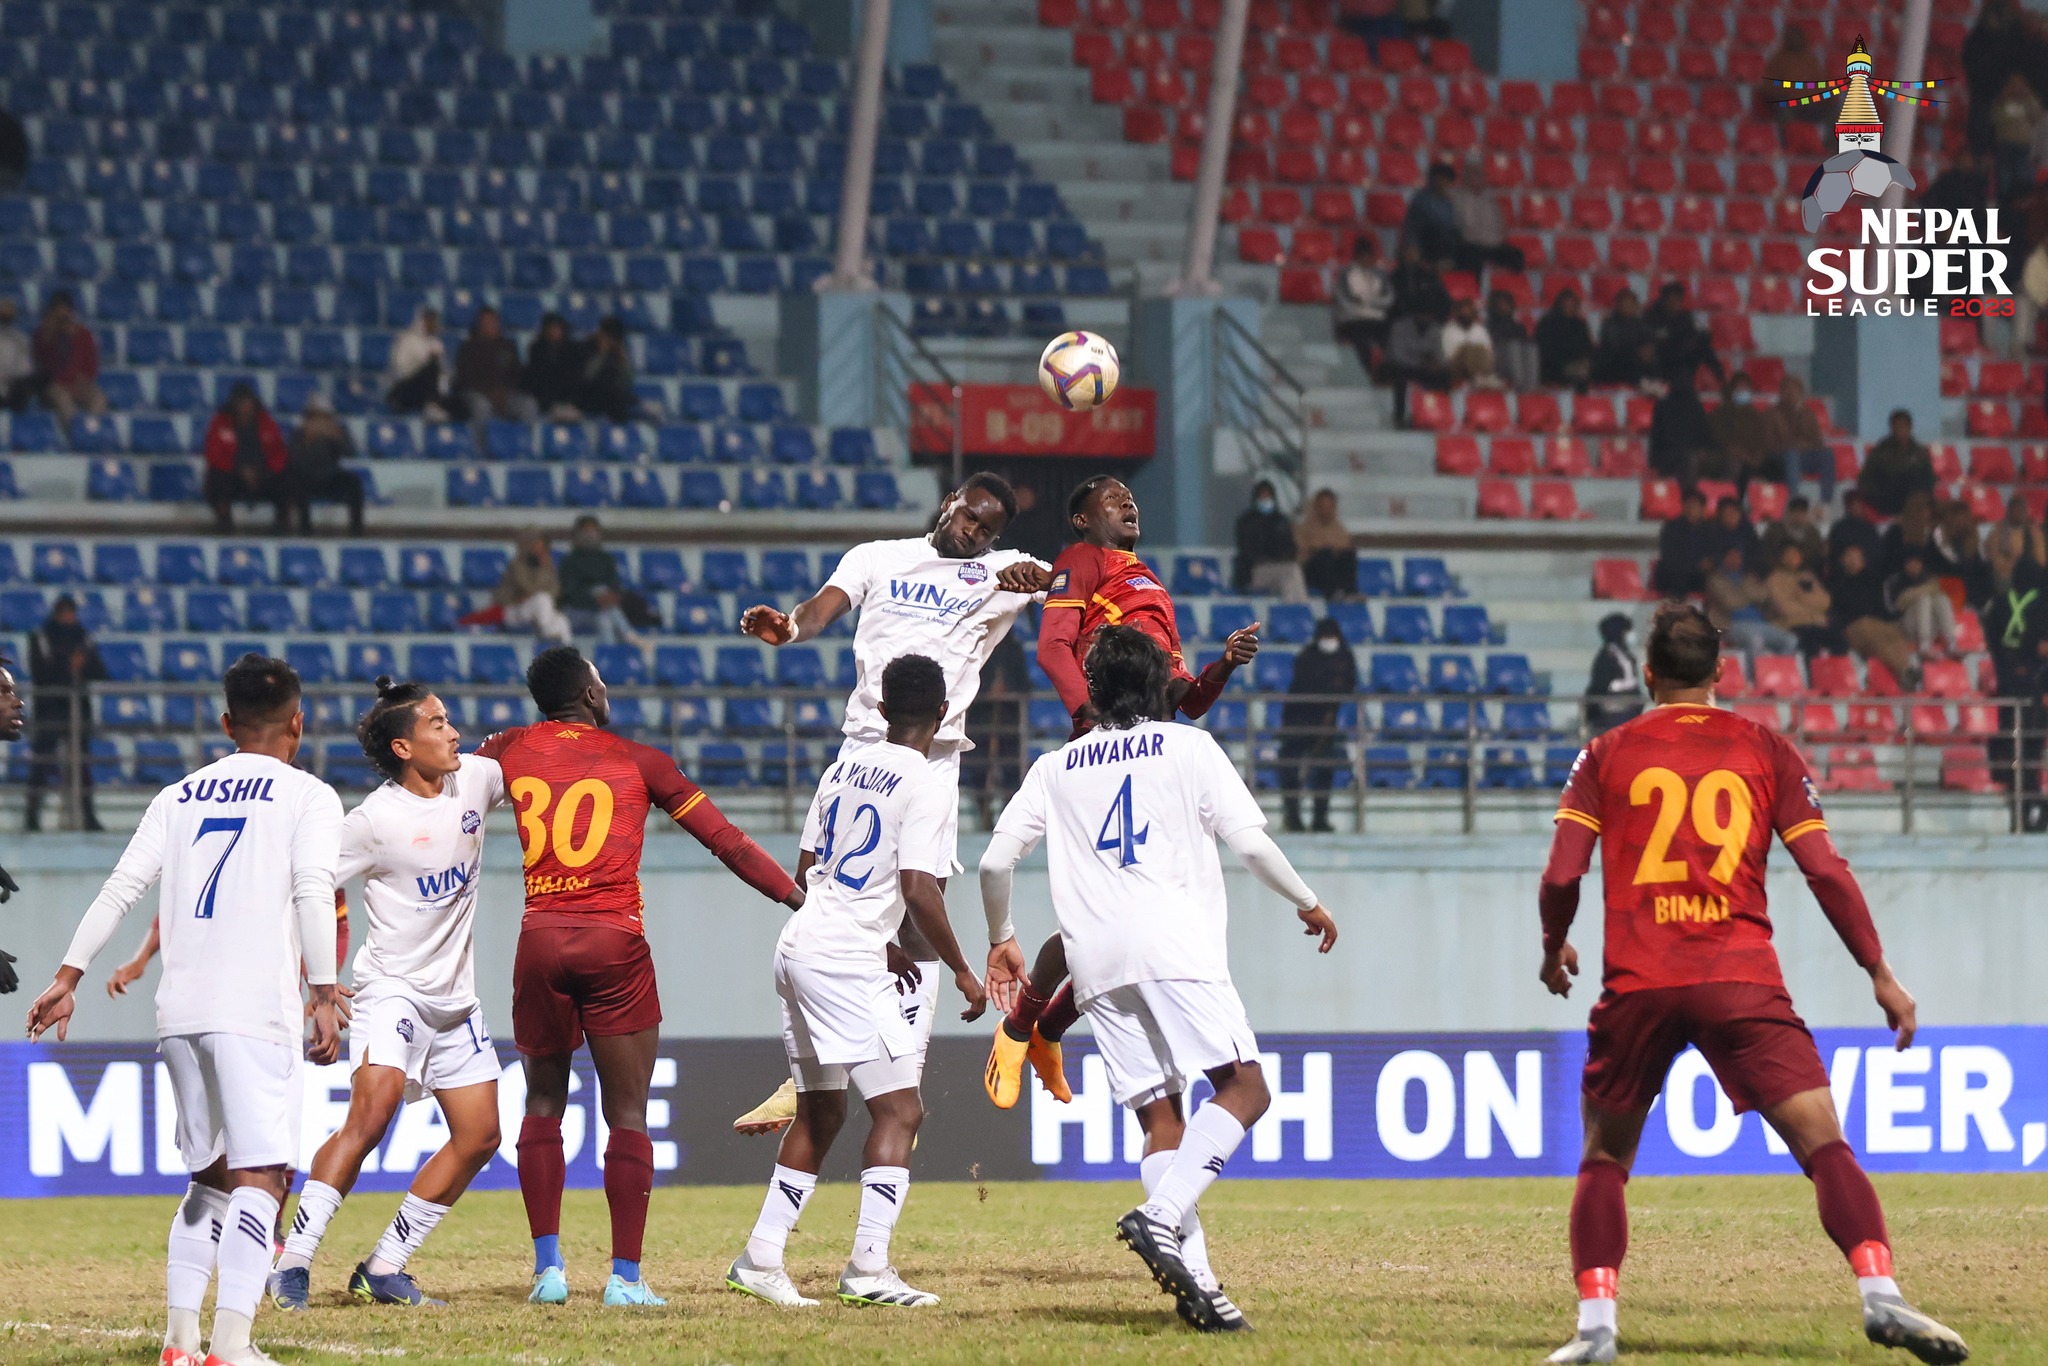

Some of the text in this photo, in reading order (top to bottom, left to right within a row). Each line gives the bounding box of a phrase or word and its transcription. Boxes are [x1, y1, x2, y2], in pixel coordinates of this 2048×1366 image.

[890, 579, 983, 618] WINgel
[177, 777, 274, 803] SUSHIL
[1065, 733, 1164, 771] DIWAKAR
[510, 776, 614, 868] 30
[1095, 773, 1150, 869] 4
[1629, 766, 1753, 885] 29
[191, 817, 247, 919] 7
[415, 861, 480, 897] WIN
[1375, 1049, 1544, 1162] ON
